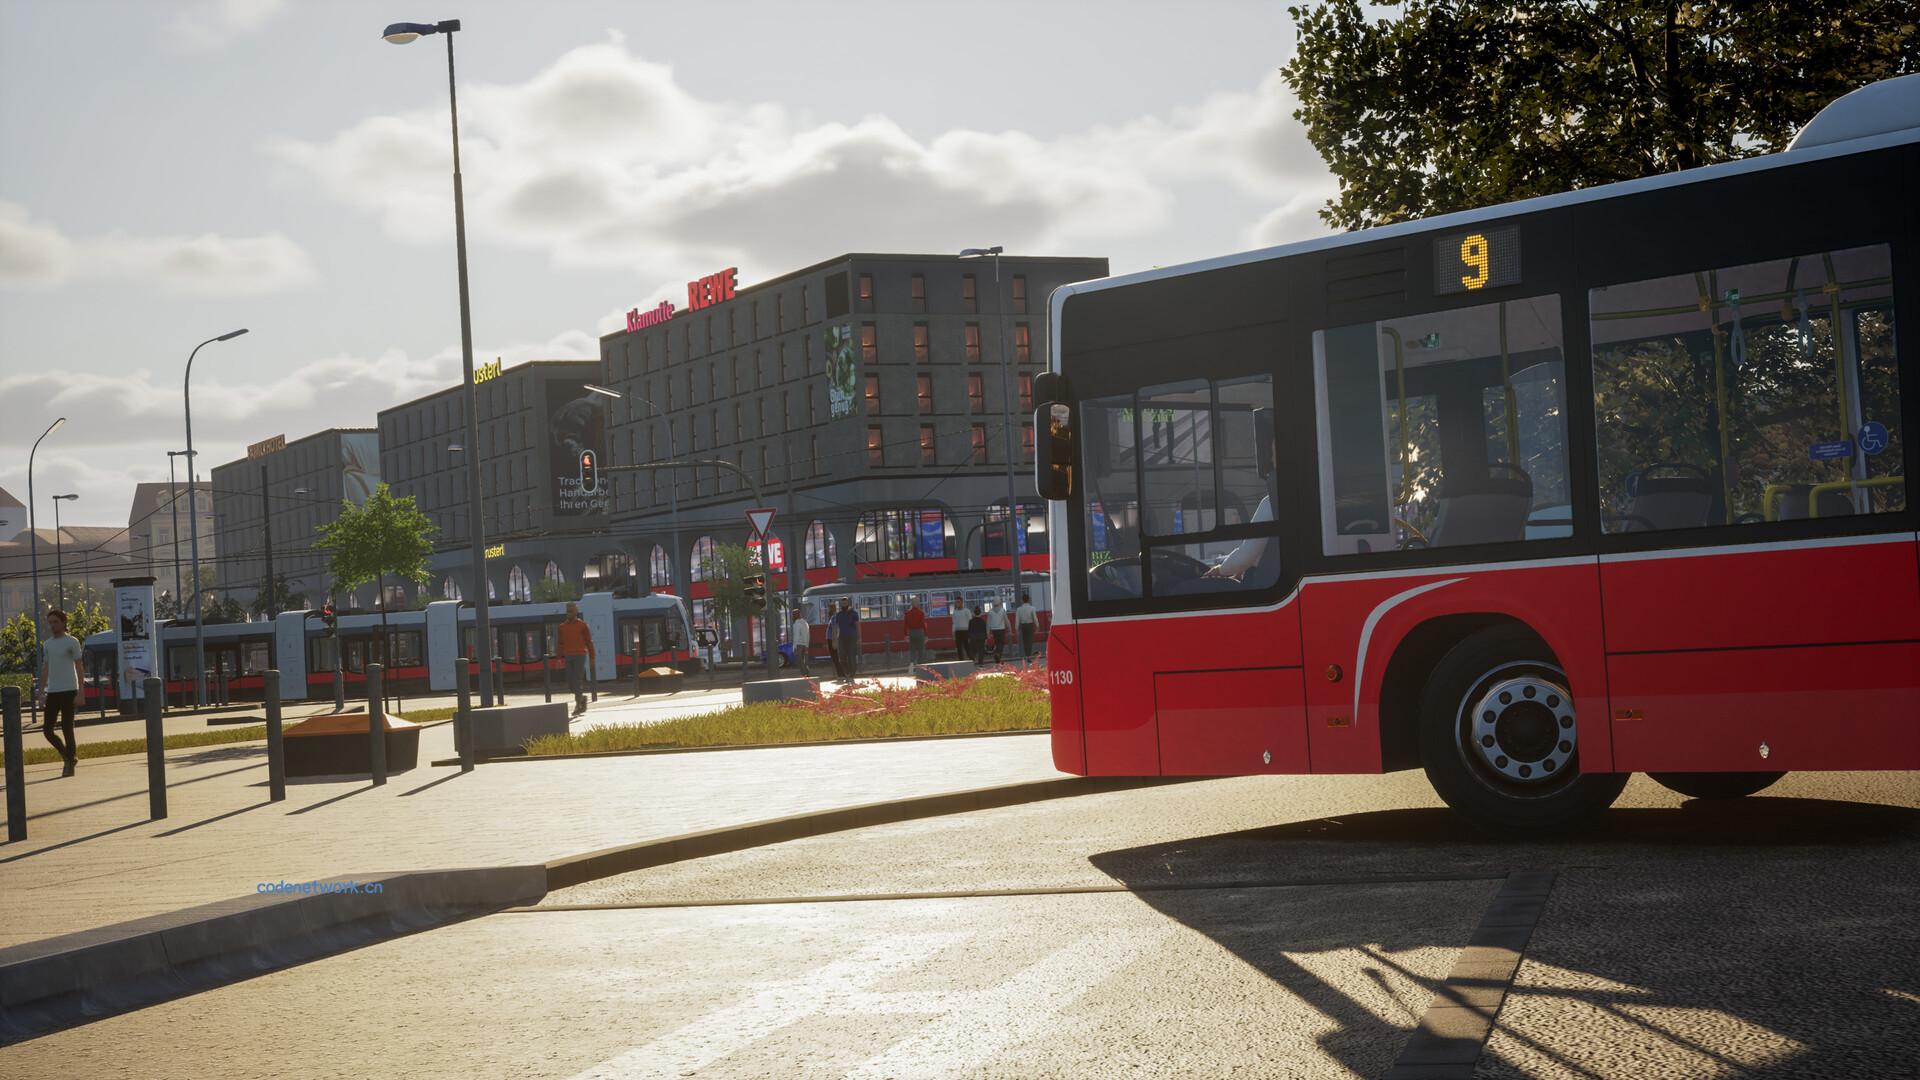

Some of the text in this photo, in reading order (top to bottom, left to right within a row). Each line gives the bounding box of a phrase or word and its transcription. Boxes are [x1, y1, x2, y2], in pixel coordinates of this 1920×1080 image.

[1461, 234, 1489, 290] 9
[687, 266, 738, 313] REWE
[1050, 670, 1073, 685] 1130
